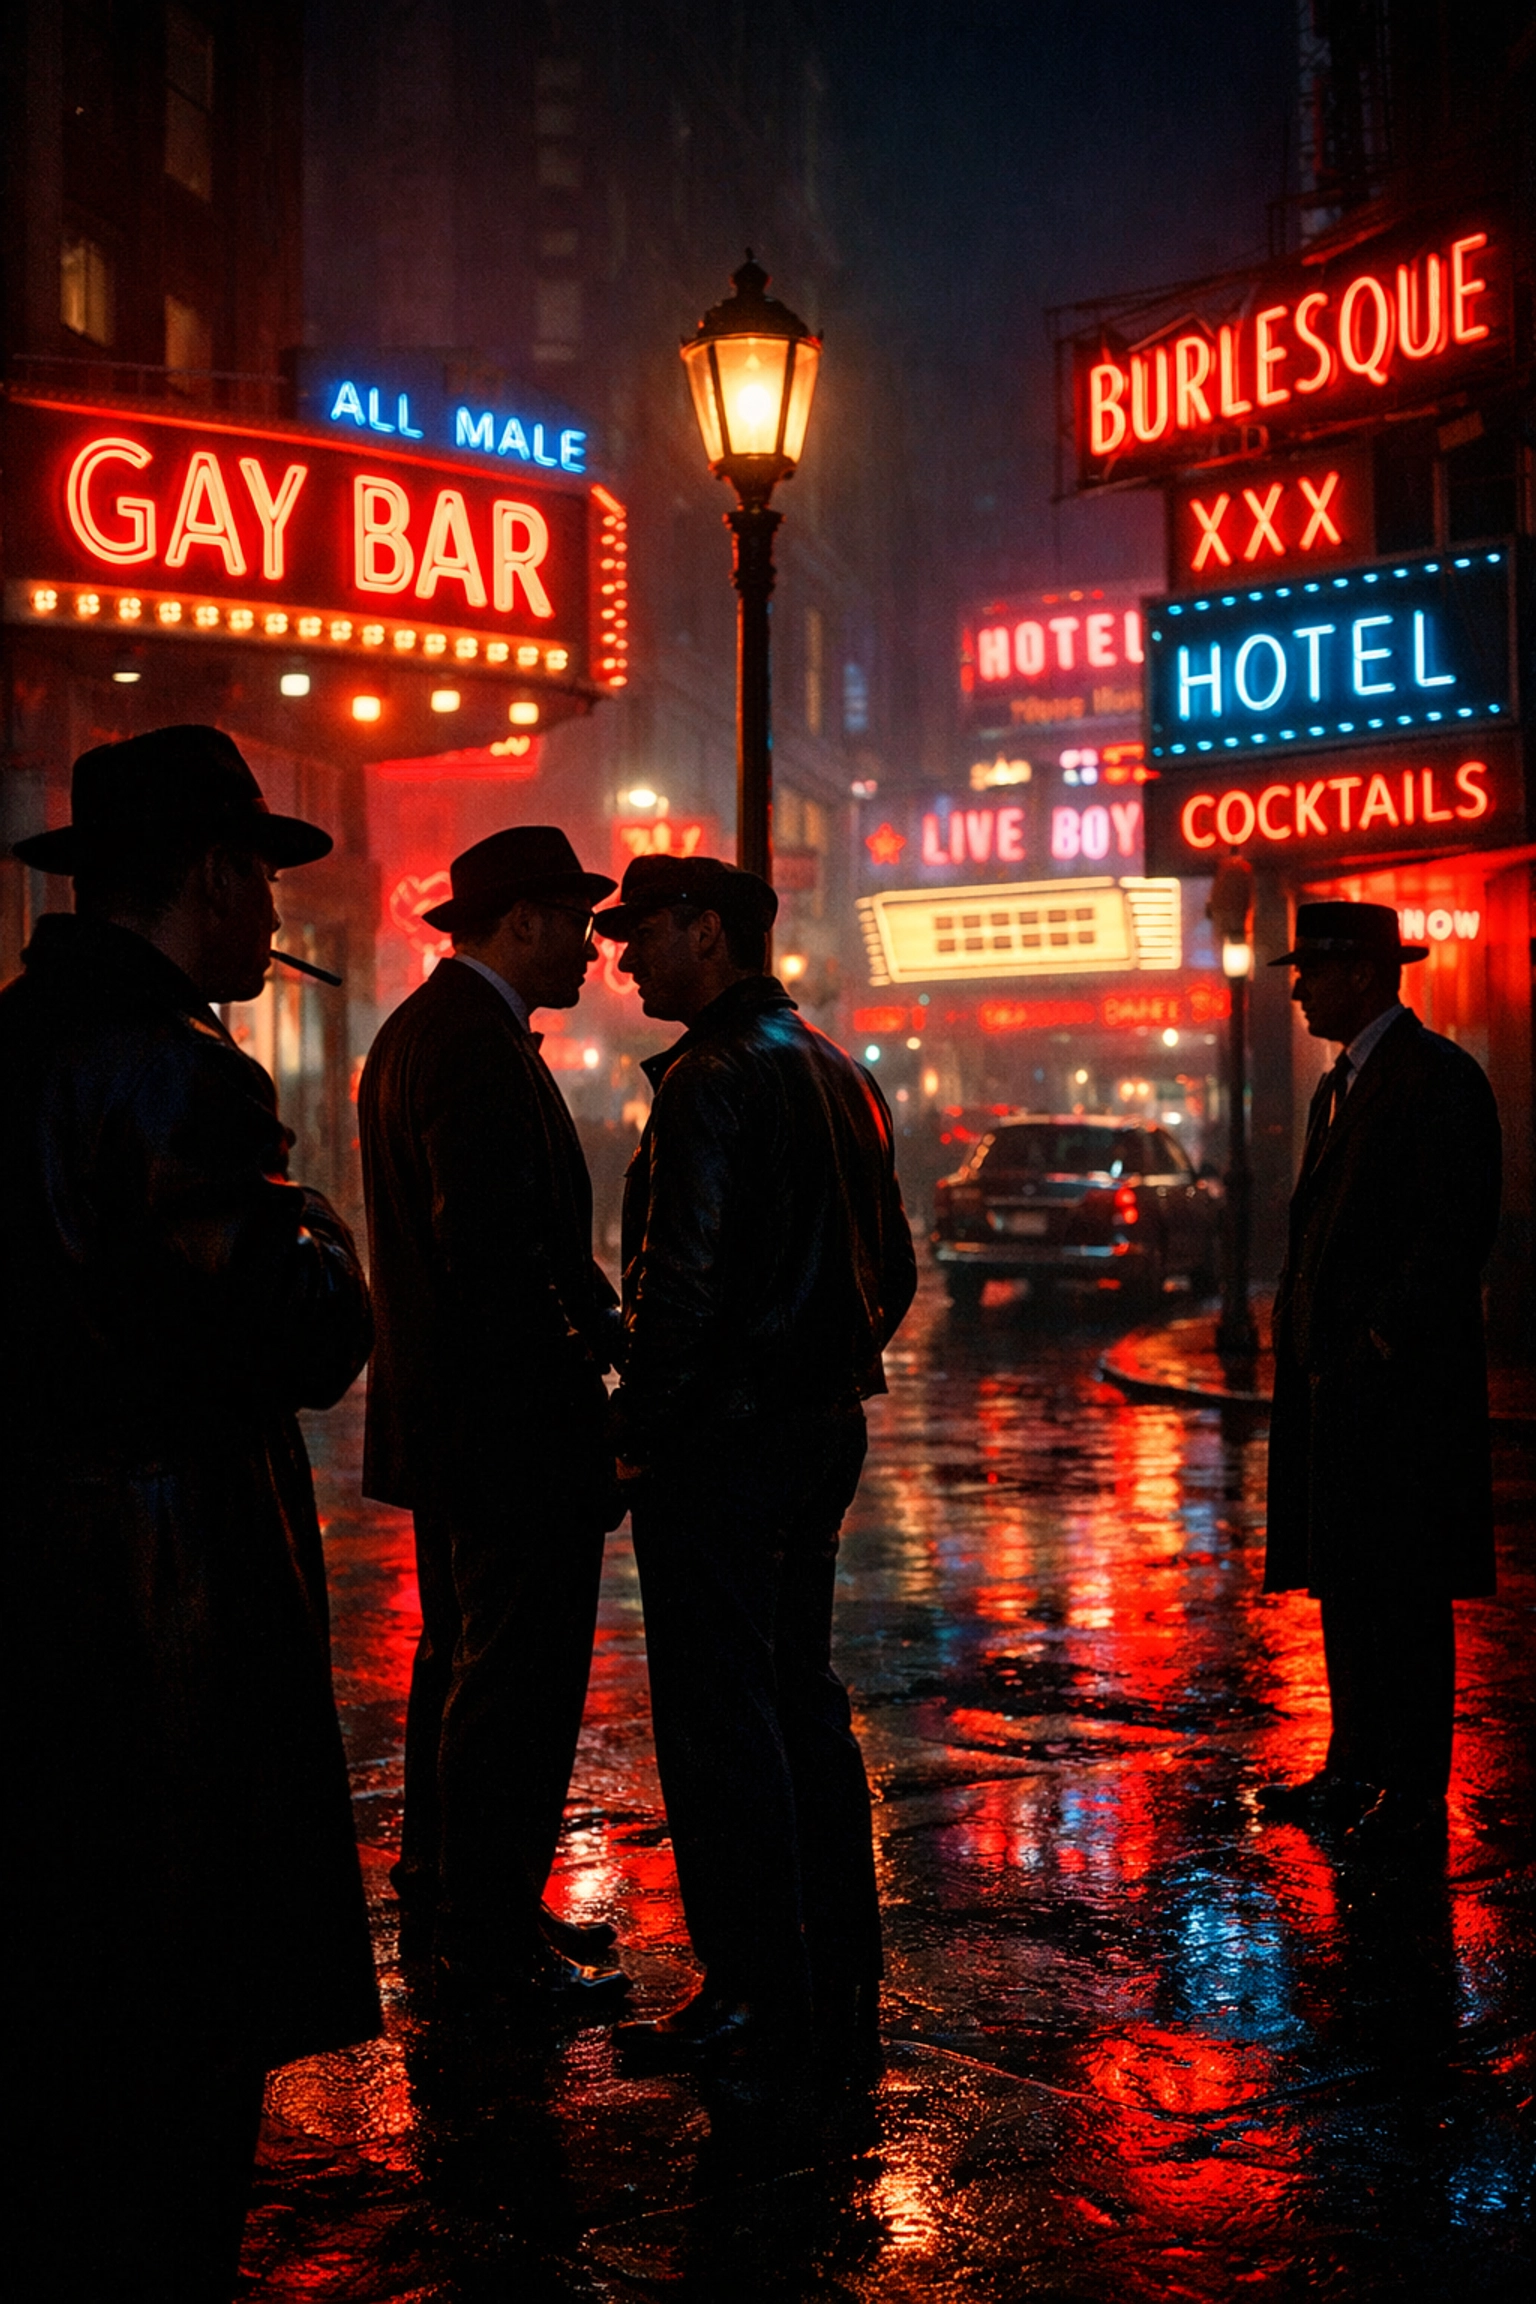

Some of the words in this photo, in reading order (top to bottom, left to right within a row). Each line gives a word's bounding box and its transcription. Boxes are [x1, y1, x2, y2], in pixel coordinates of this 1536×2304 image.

[1090, 233, 1489, 456] BURLESQUE
[330, 380, 424, 439] ALL
[455, 406, 587, 474] MALE
[66, 437, 308, 581] GAY
[353, 474, 555, 619] BAR
[1191, 471, 1342, 571] XXX
[979, 609, 1145, 681] HOTEL
[1177, 609, 1457, 721] HOTEL
[922, 807, 1025, 866] LIVE
[1051, 801, 1141, 860] BOY
[1181, 762, 1489, 848] COCKTAILS
